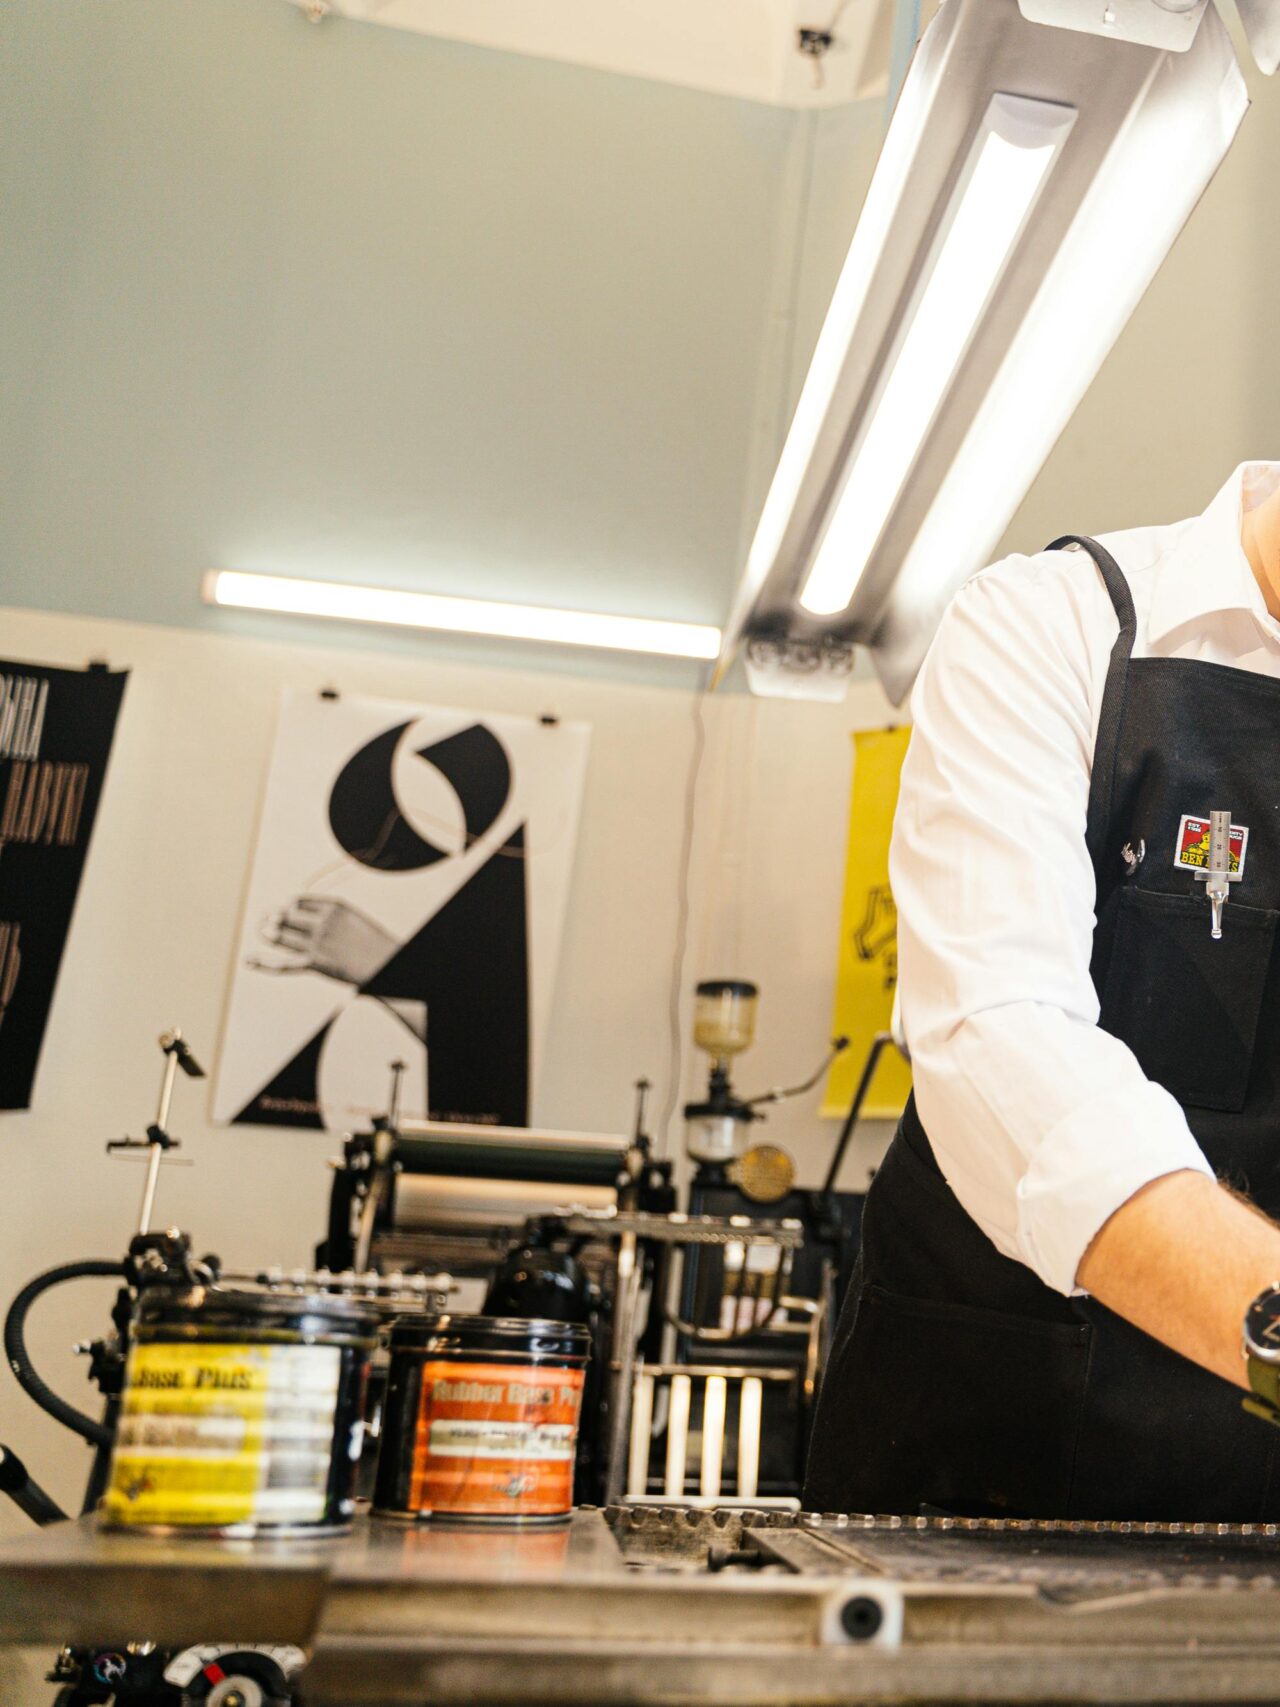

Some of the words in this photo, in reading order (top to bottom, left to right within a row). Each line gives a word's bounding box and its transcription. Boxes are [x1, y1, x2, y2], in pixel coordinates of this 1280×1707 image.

[1181, 851, 1205, 866] BEN
[432, 1379, 504, 1404] Rubber
[507, 1382, 555, 1405] Base
